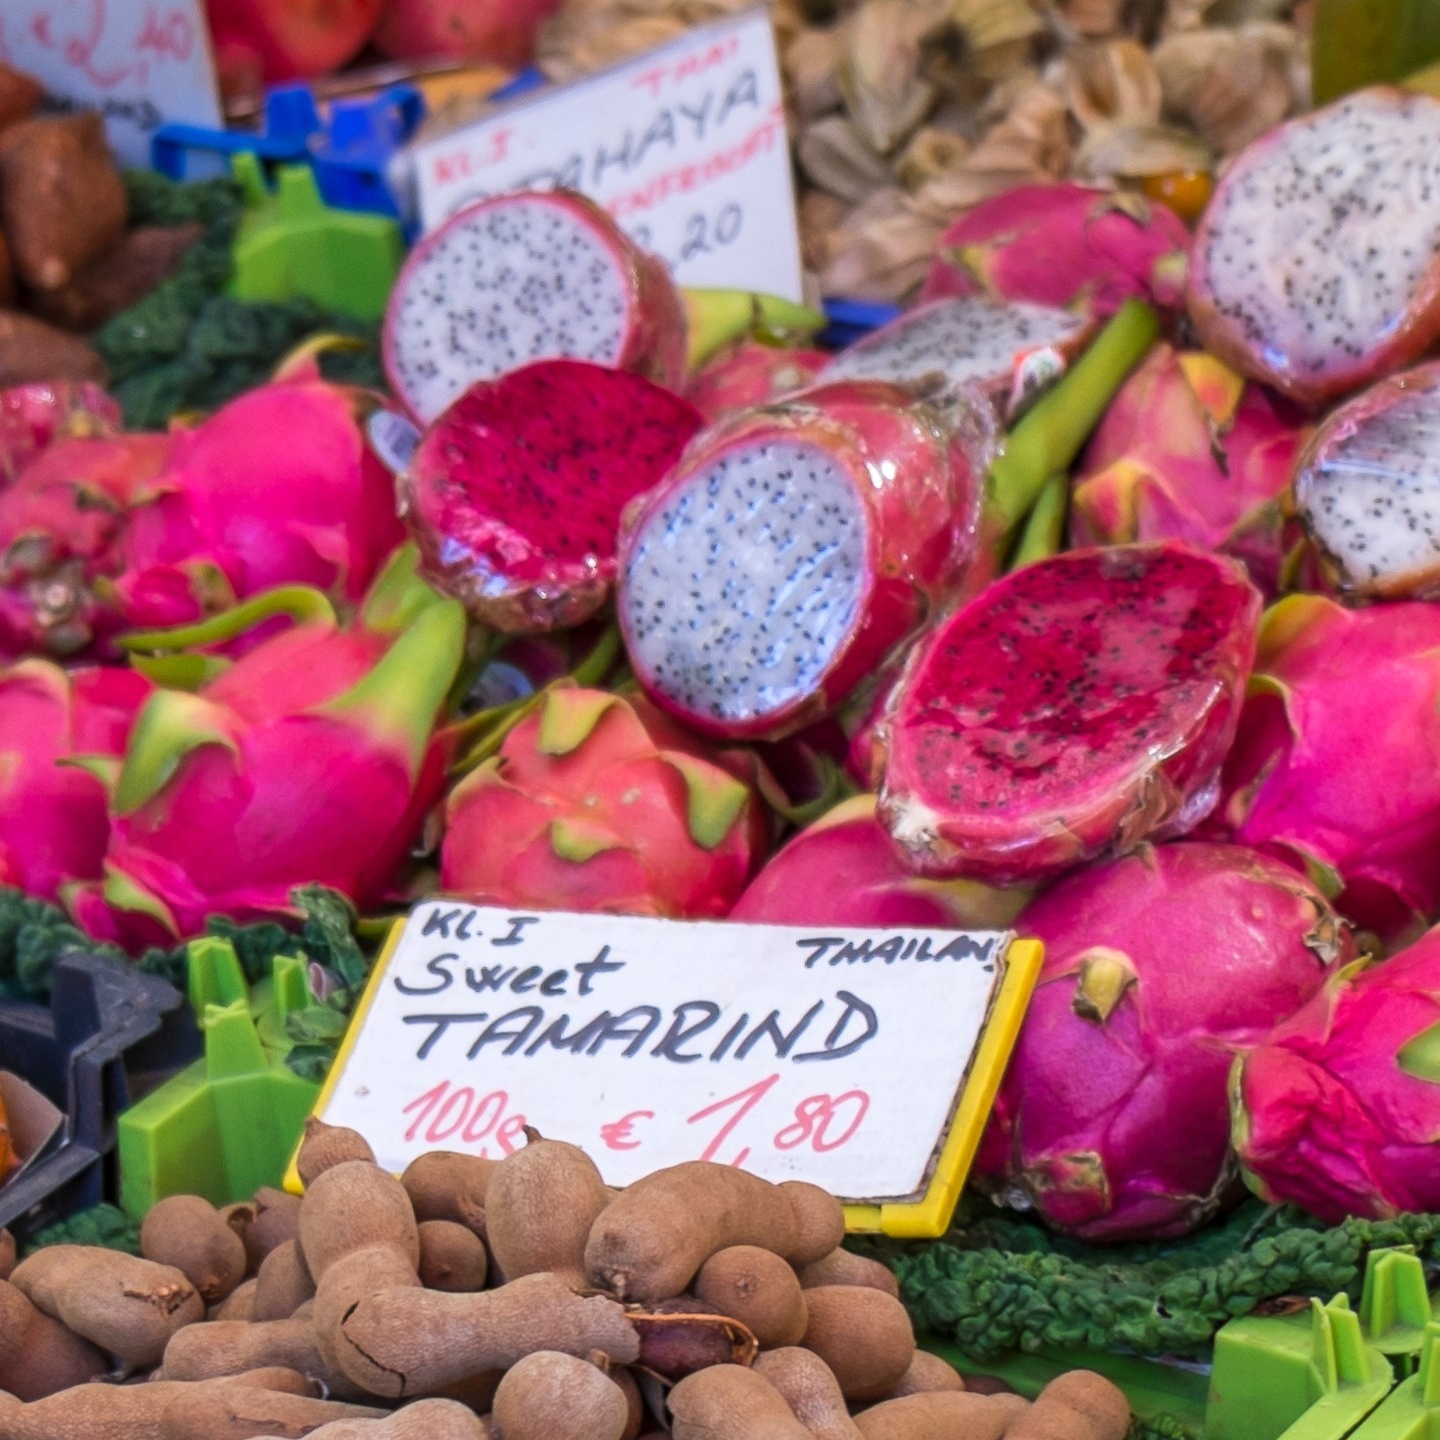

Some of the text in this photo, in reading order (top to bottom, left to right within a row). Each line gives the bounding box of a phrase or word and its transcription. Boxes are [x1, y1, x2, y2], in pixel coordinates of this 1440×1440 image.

[395, 945, 625, 996] Sweet
[796, 935, 999, 972] THAILAN
[402, 990, 881, 1063] TAMARIND
